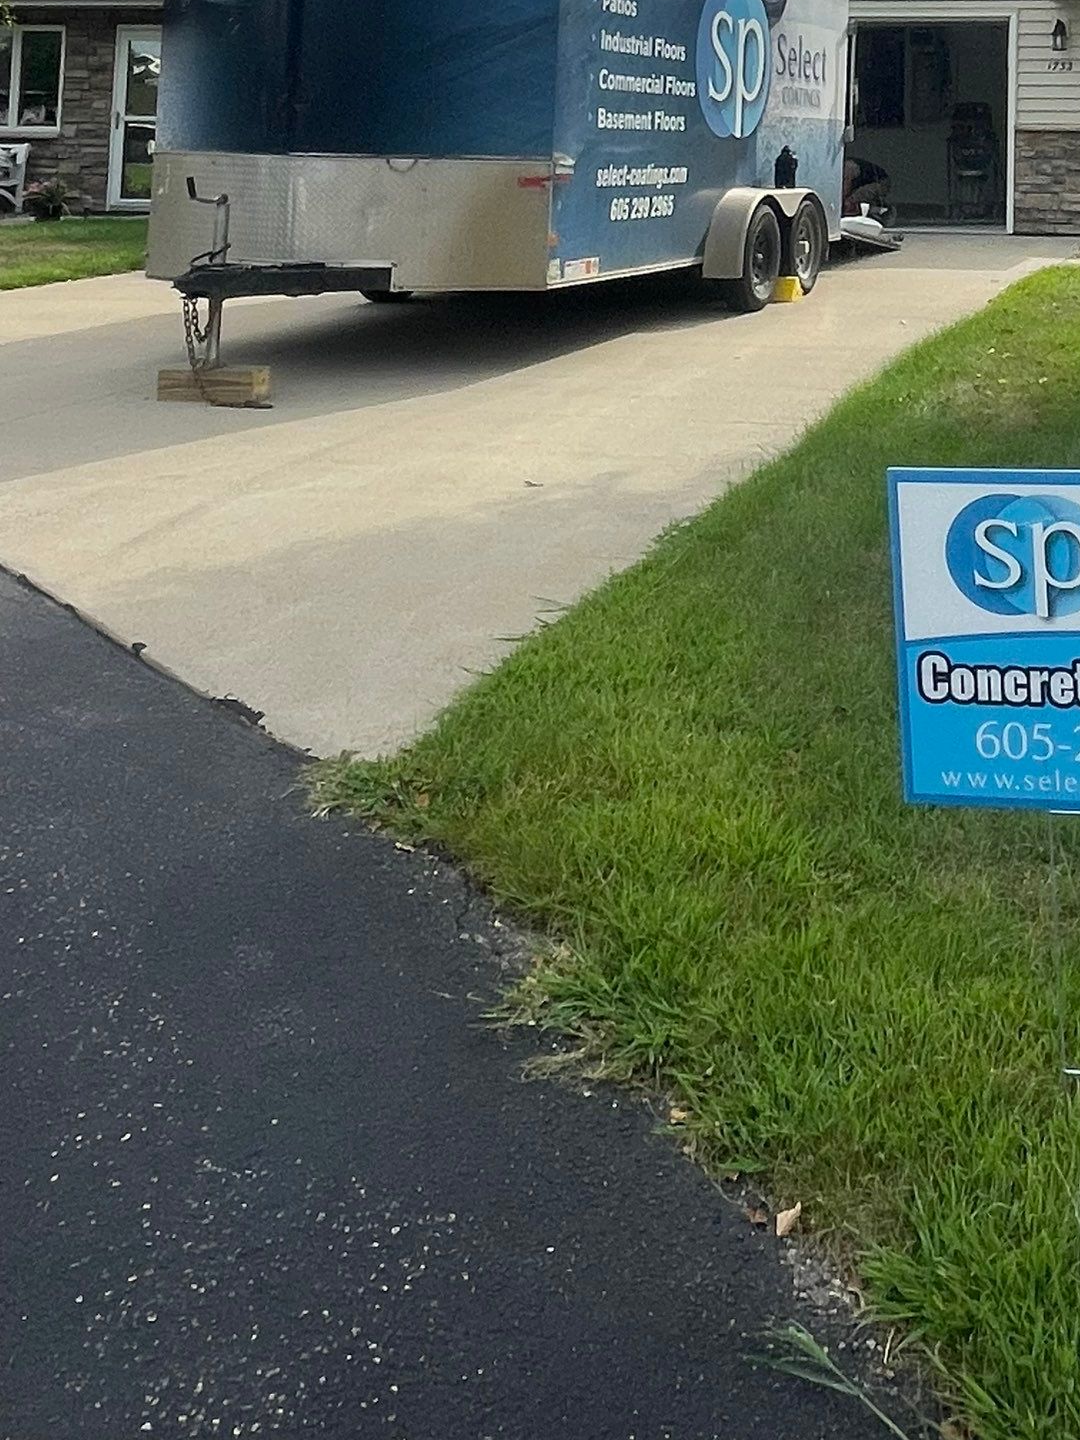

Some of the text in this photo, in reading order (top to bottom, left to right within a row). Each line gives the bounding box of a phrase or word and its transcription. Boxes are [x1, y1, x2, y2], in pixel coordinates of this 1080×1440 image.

[600, 29, 686, 62] Industrial Floors
[776, 33, 827, 83] Select
[599, 69, 696, 98] Commercial Floors
[782, 86, 821, 108] COATINGS
[597, 108, 686, 132] Basement Floors
[596, 163, 688, 189] select-coatings.com
[610, 194, 675, 221] 605 299 2965
